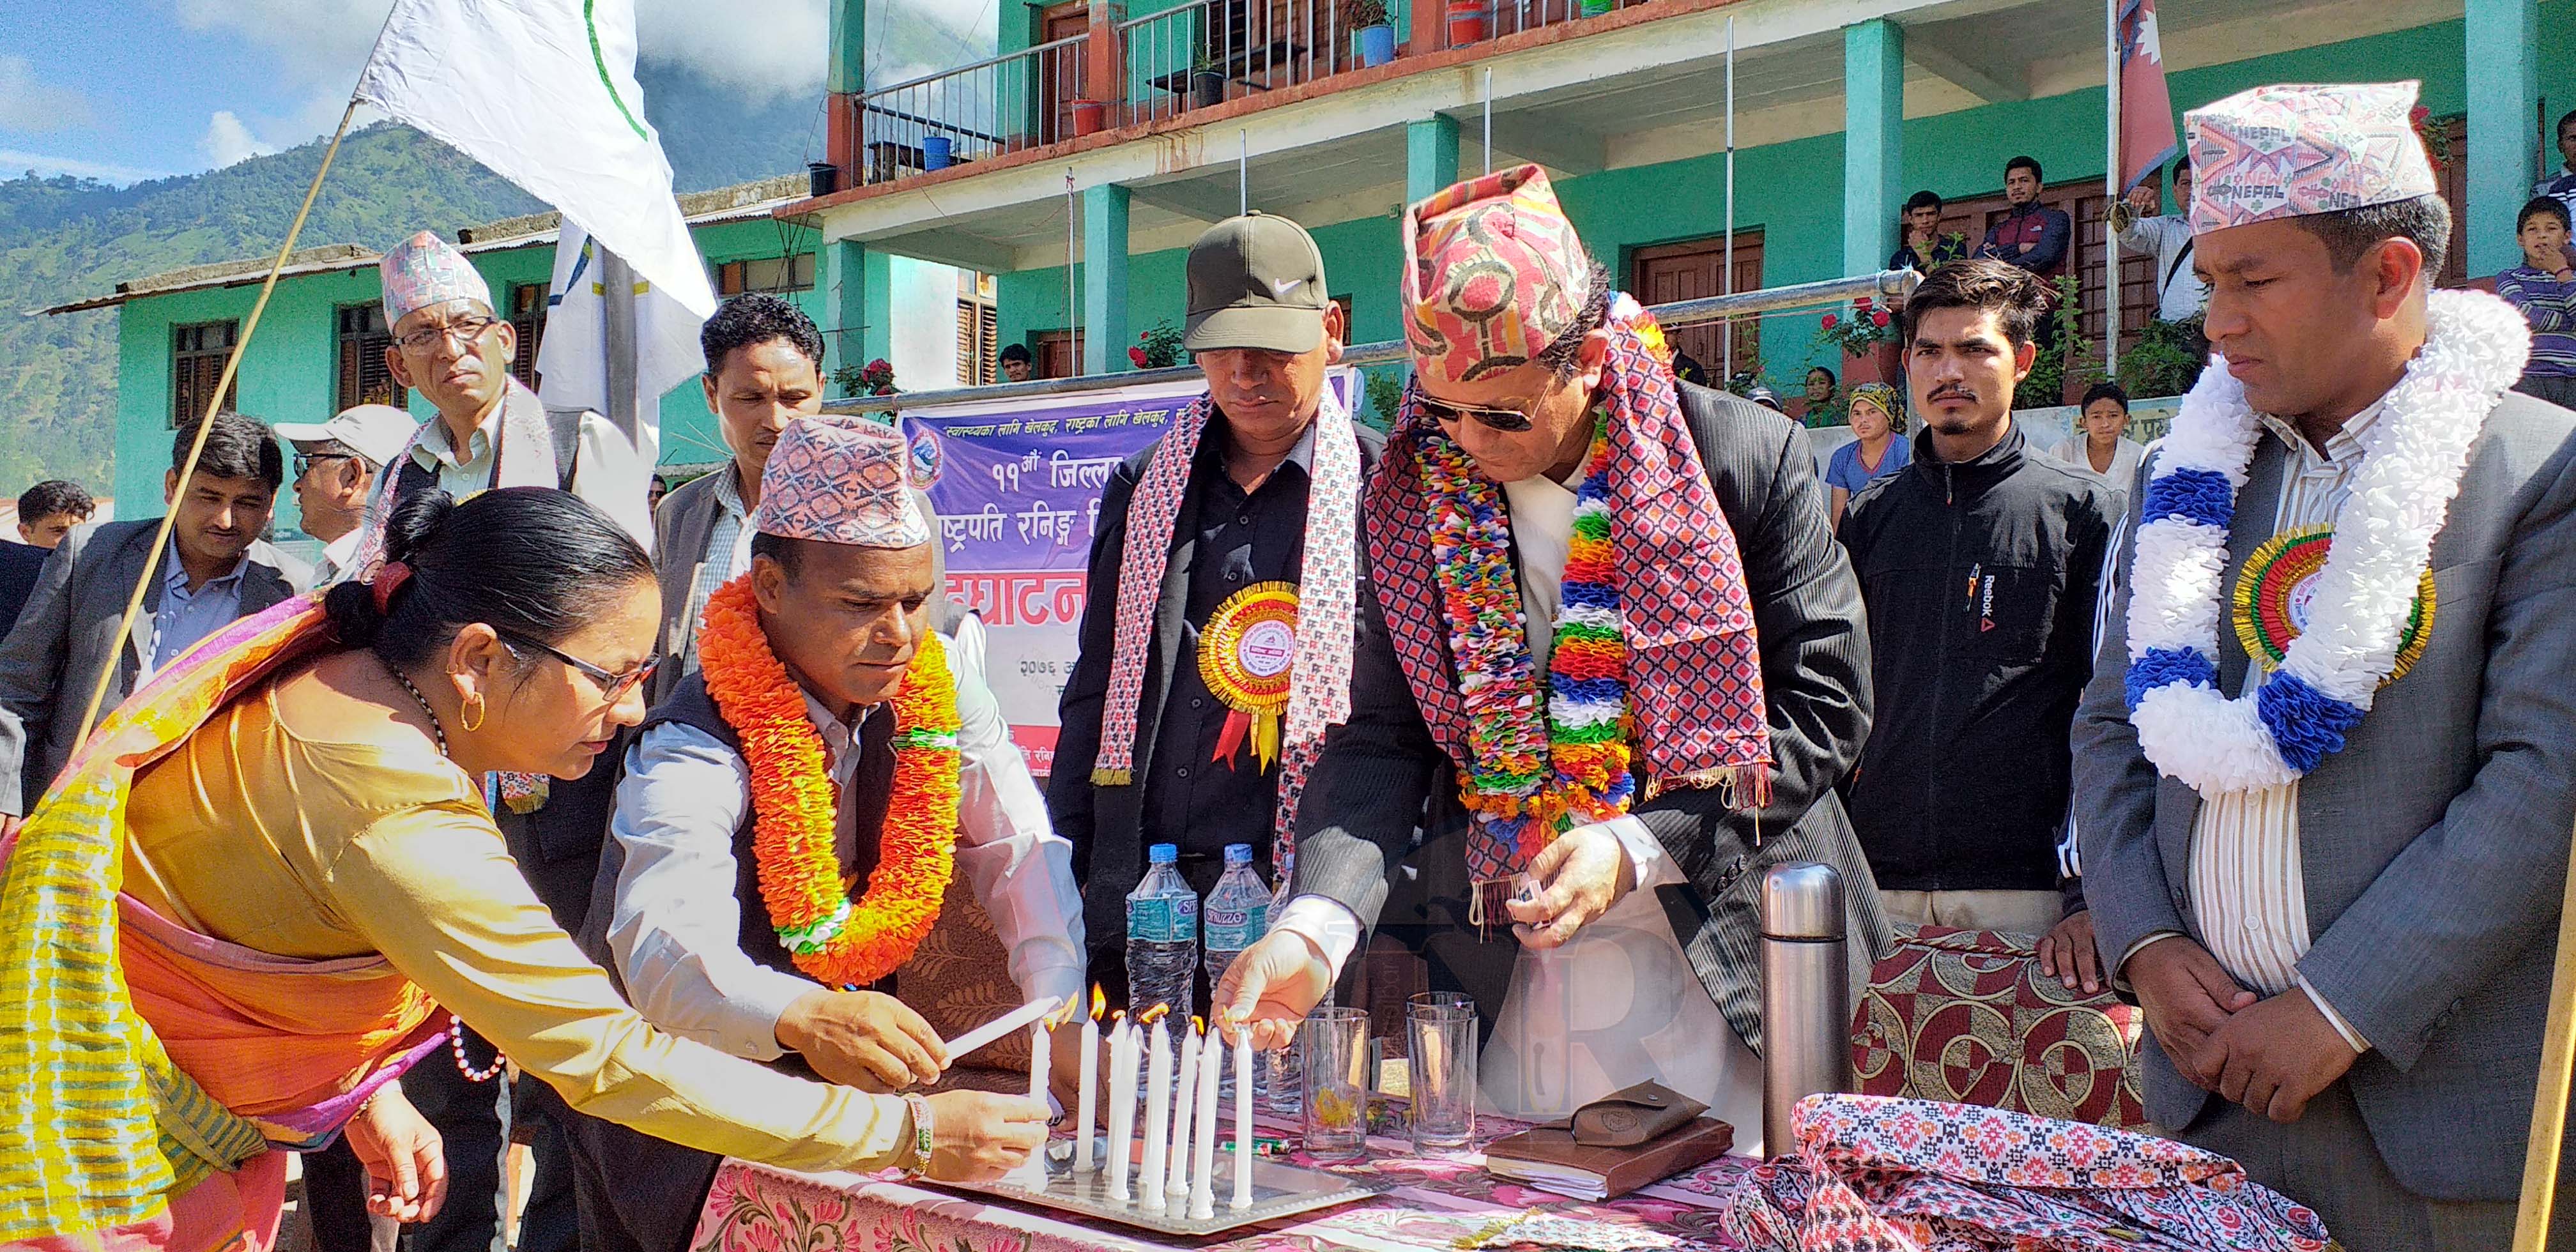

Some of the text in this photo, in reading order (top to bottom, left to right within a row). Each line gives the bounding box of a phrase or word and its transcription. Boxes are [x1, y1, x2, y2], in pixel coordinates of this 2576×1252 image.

[2244, 171, 2283, 186] NEW
[2231, 185, 2284, 199] NEPAL
[998, 419, 1022, 437] लागि
[1104, 409, 1130, 431] लागि
[1981, 575, 1995, 617] Reebok
[1020, 660, 1056, 676] २०७६
[1207, 908, 1242, 924] SPRUZZO
